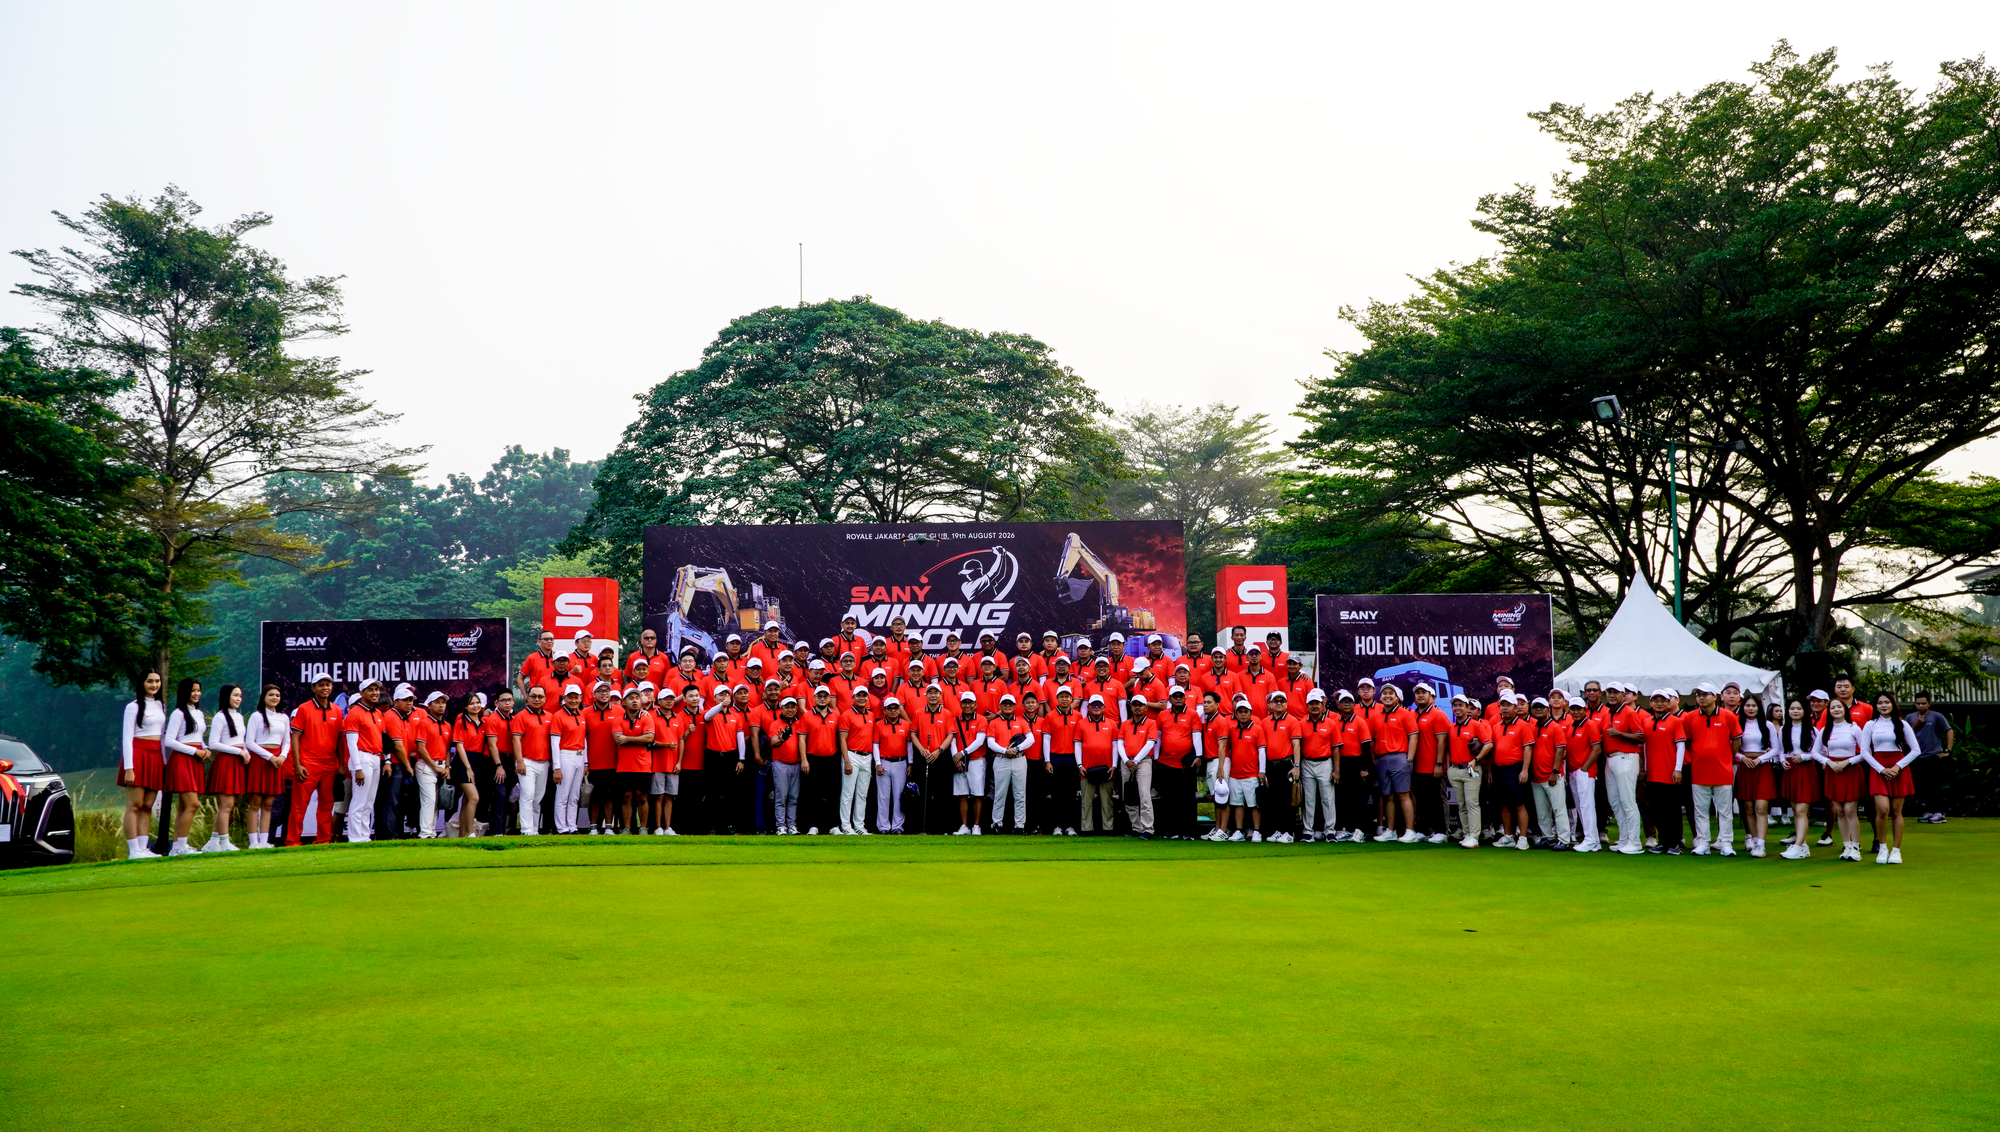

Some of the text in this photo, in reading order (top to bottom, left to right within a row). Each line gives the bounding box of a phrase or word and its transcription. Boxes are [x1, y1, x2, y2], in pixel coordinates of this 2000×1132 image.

[850, 585, 932, 603] SANY
[1237, 580, 1276, 614] S
[555, 592, 594, 627] S
[848, 602, 1014, 627] MINING
[1339, 610, 1379, 620] SANY
[285, 636, 328, 647] SANY
[1355, 635, 1515, 656] HOLE IN ONE WINNER
[347, 661, 364, 683] IN
[368, 661, 401, 682] ONE
[405, 659, 469, 681] WINNER
